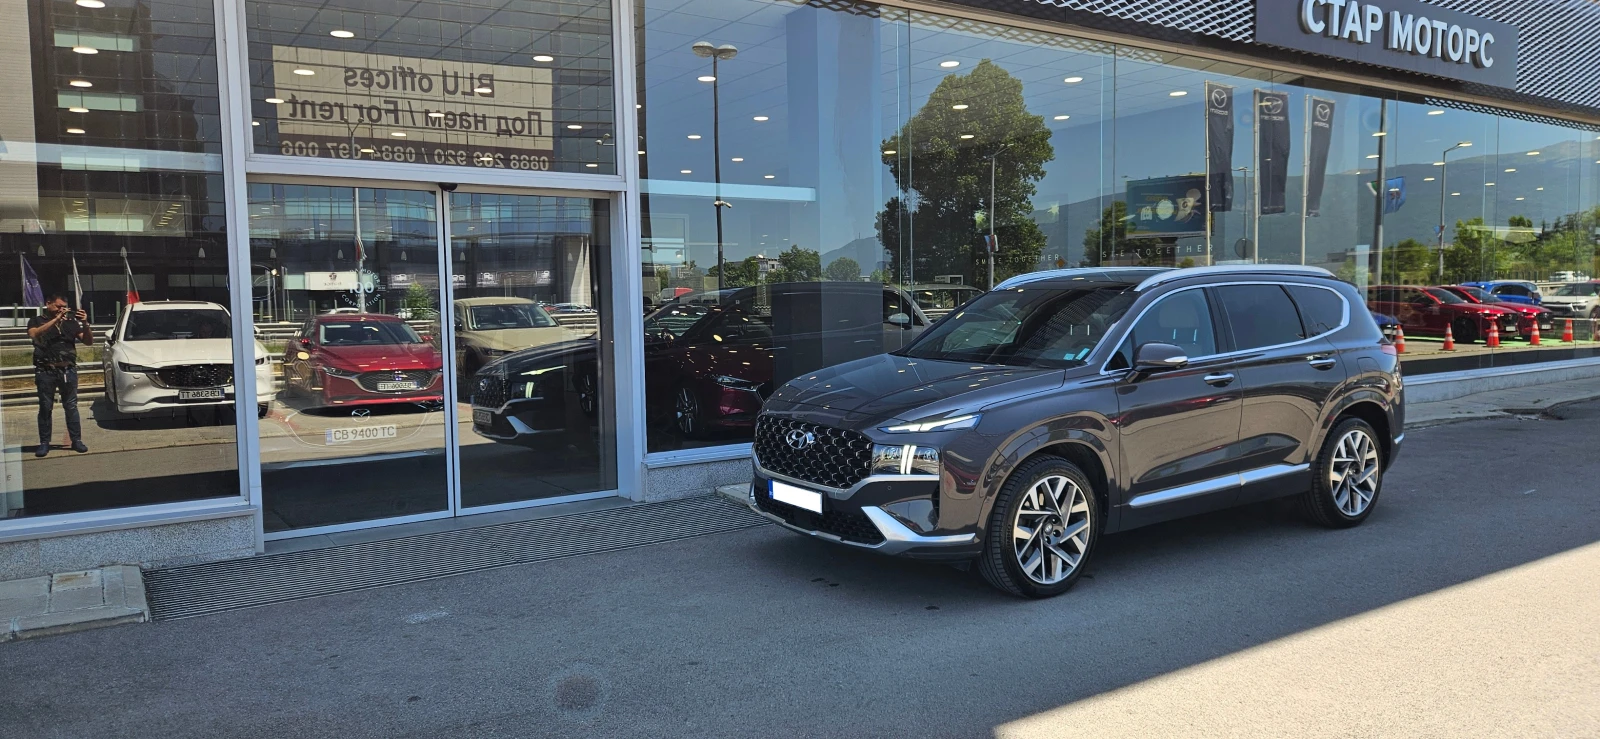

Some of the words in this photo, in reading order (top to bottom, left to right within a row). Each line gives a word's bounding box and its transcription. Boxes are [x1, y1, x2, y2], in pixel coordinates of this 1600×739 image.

[1303, 0, 1383, 44] СТАР
[1389, 10, 1495, 68] МОТОРС
[1136, 244, 1214, 257] TOGETHER
[341, 293, 381, 308] CORPOATION
[333, 429, 349, 441] CB
[351, 427, 378, 439] 9400
[379, 425, 395, 437] TC
